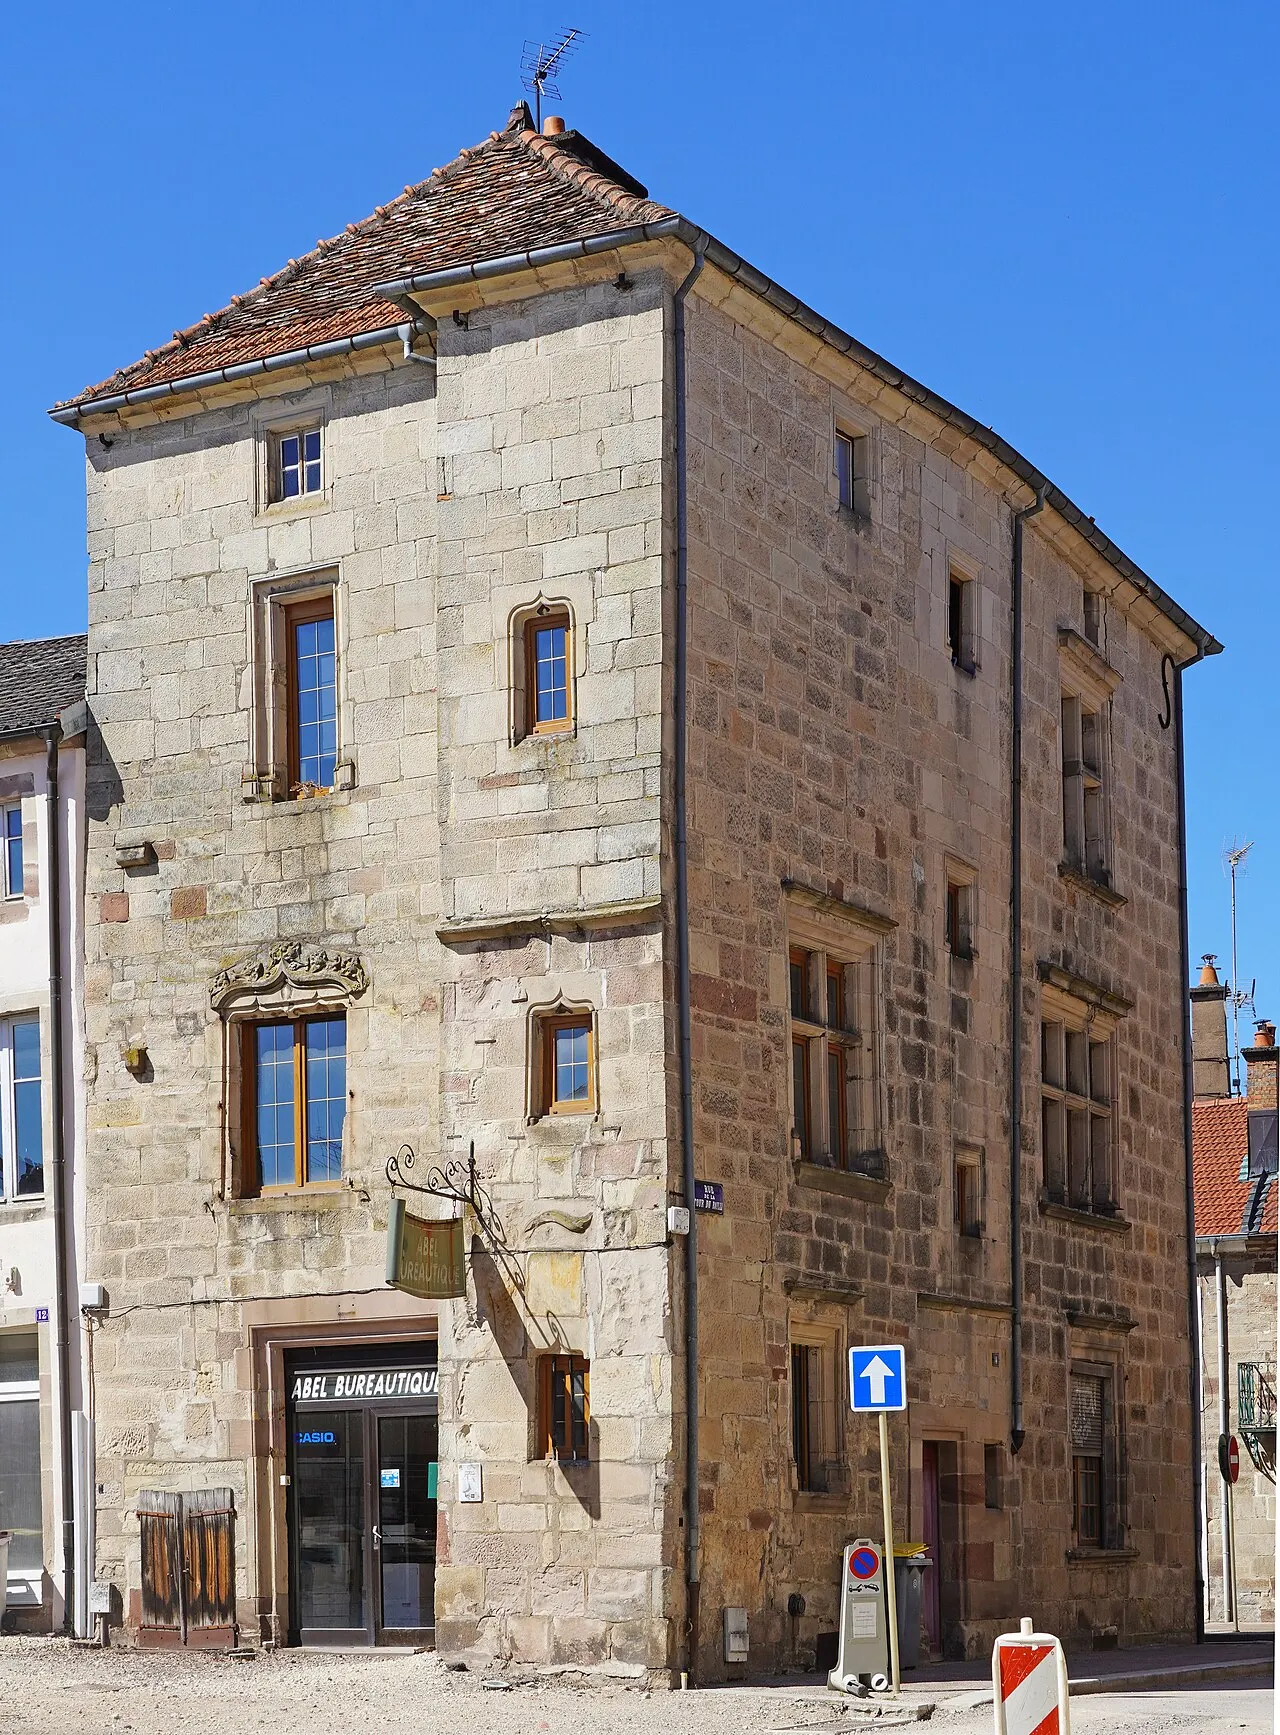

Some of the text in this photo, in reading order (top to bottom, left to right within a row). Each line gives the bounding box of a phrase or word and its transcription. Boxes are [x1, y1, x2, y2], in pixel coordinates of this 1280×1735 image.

[704, 1184, 714, 1194] RUE
[415, 1236, 438, 1257] ABEL
[400, 1260, 460, 1285] UREAUTIQUE
[37, 1310, 47, 1320] 12
[292, 1376, 328, 1399] ABEL
[294, 1432, 334, 1443] CASIO
